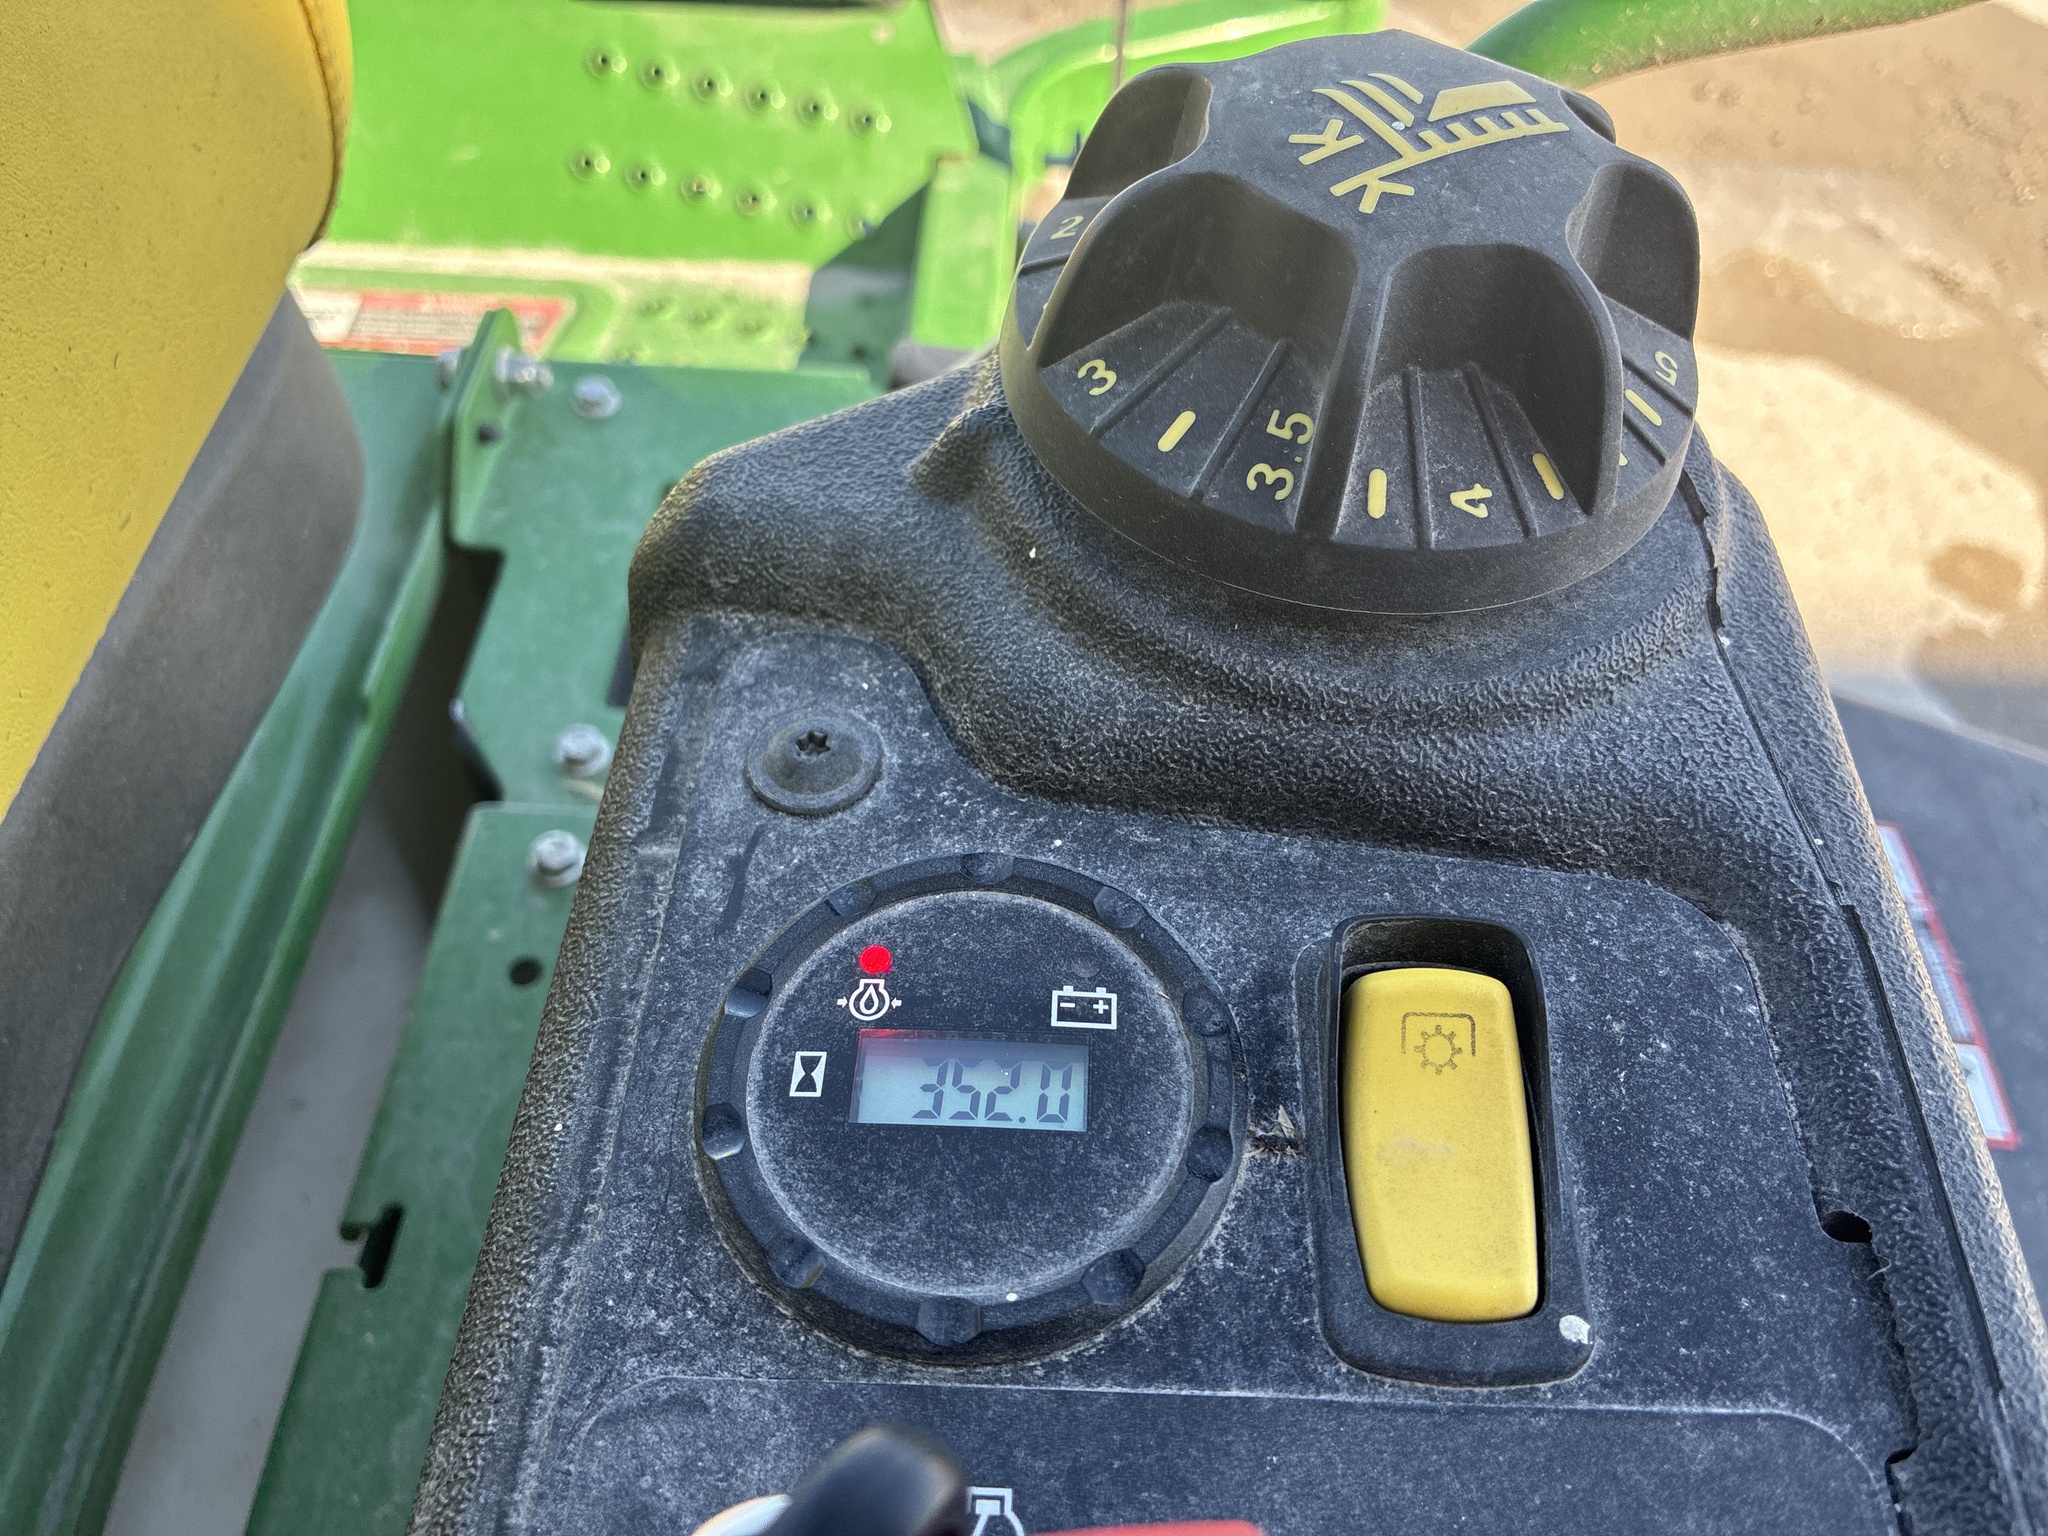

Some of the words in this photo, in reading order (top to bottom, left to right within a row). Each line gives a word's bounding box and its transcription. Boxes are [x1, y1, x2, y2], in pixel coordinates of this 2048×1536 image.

[1050, 216, 1084, 240] 2
[1077, 358, 1118, 396] 3
[1654, 351, 1678, 386] 5
[1246, 409, 1315, 501] 3.5
[1450, 483, 1493, 518] 4
[911, 1058, 1073, 1123] 352.0
